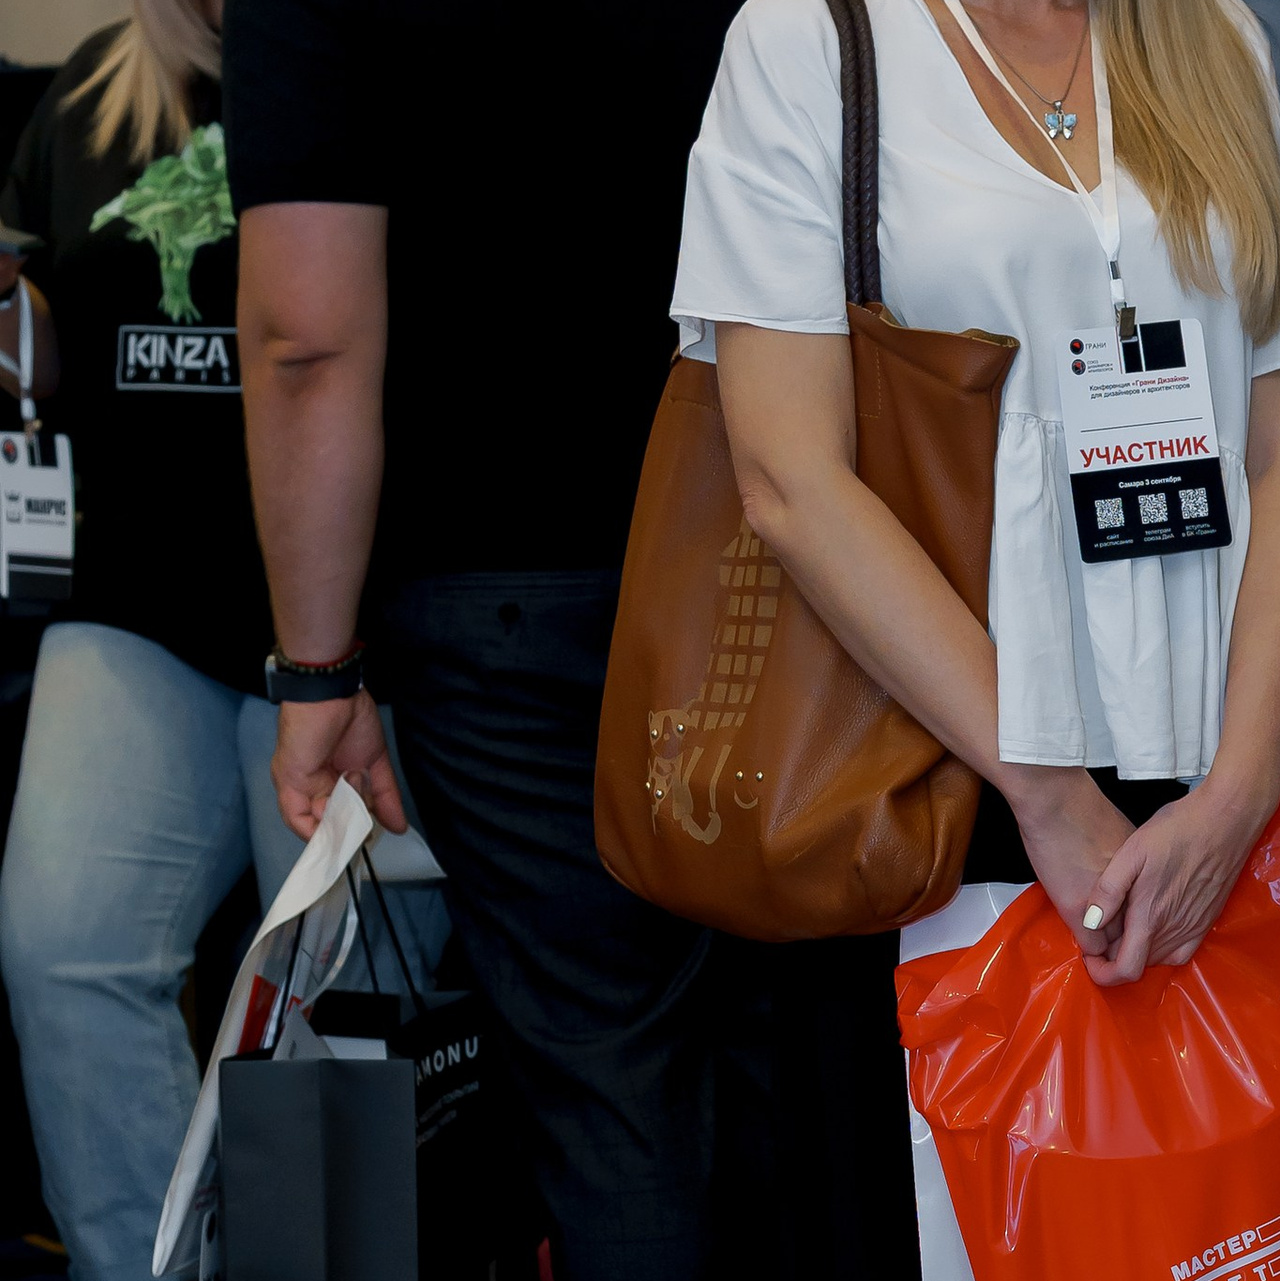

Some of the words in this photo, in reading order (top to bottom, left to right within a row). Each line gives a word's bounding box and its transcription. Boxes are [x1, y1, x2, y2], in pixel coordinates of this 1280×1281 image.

[128, 333, 229, 369] KINZA
[1085, 342, 1107, 351] ГРАНИ
[1089, 381, 1131, 392] Конференция
[1103, 387, 1140, 398] дизайнеров
[1080, 435, 1210, 468] УЧАСТНИК
[1118, 481, 1145, 489] Самара
[1150, 475, 1182, 485] сентября
